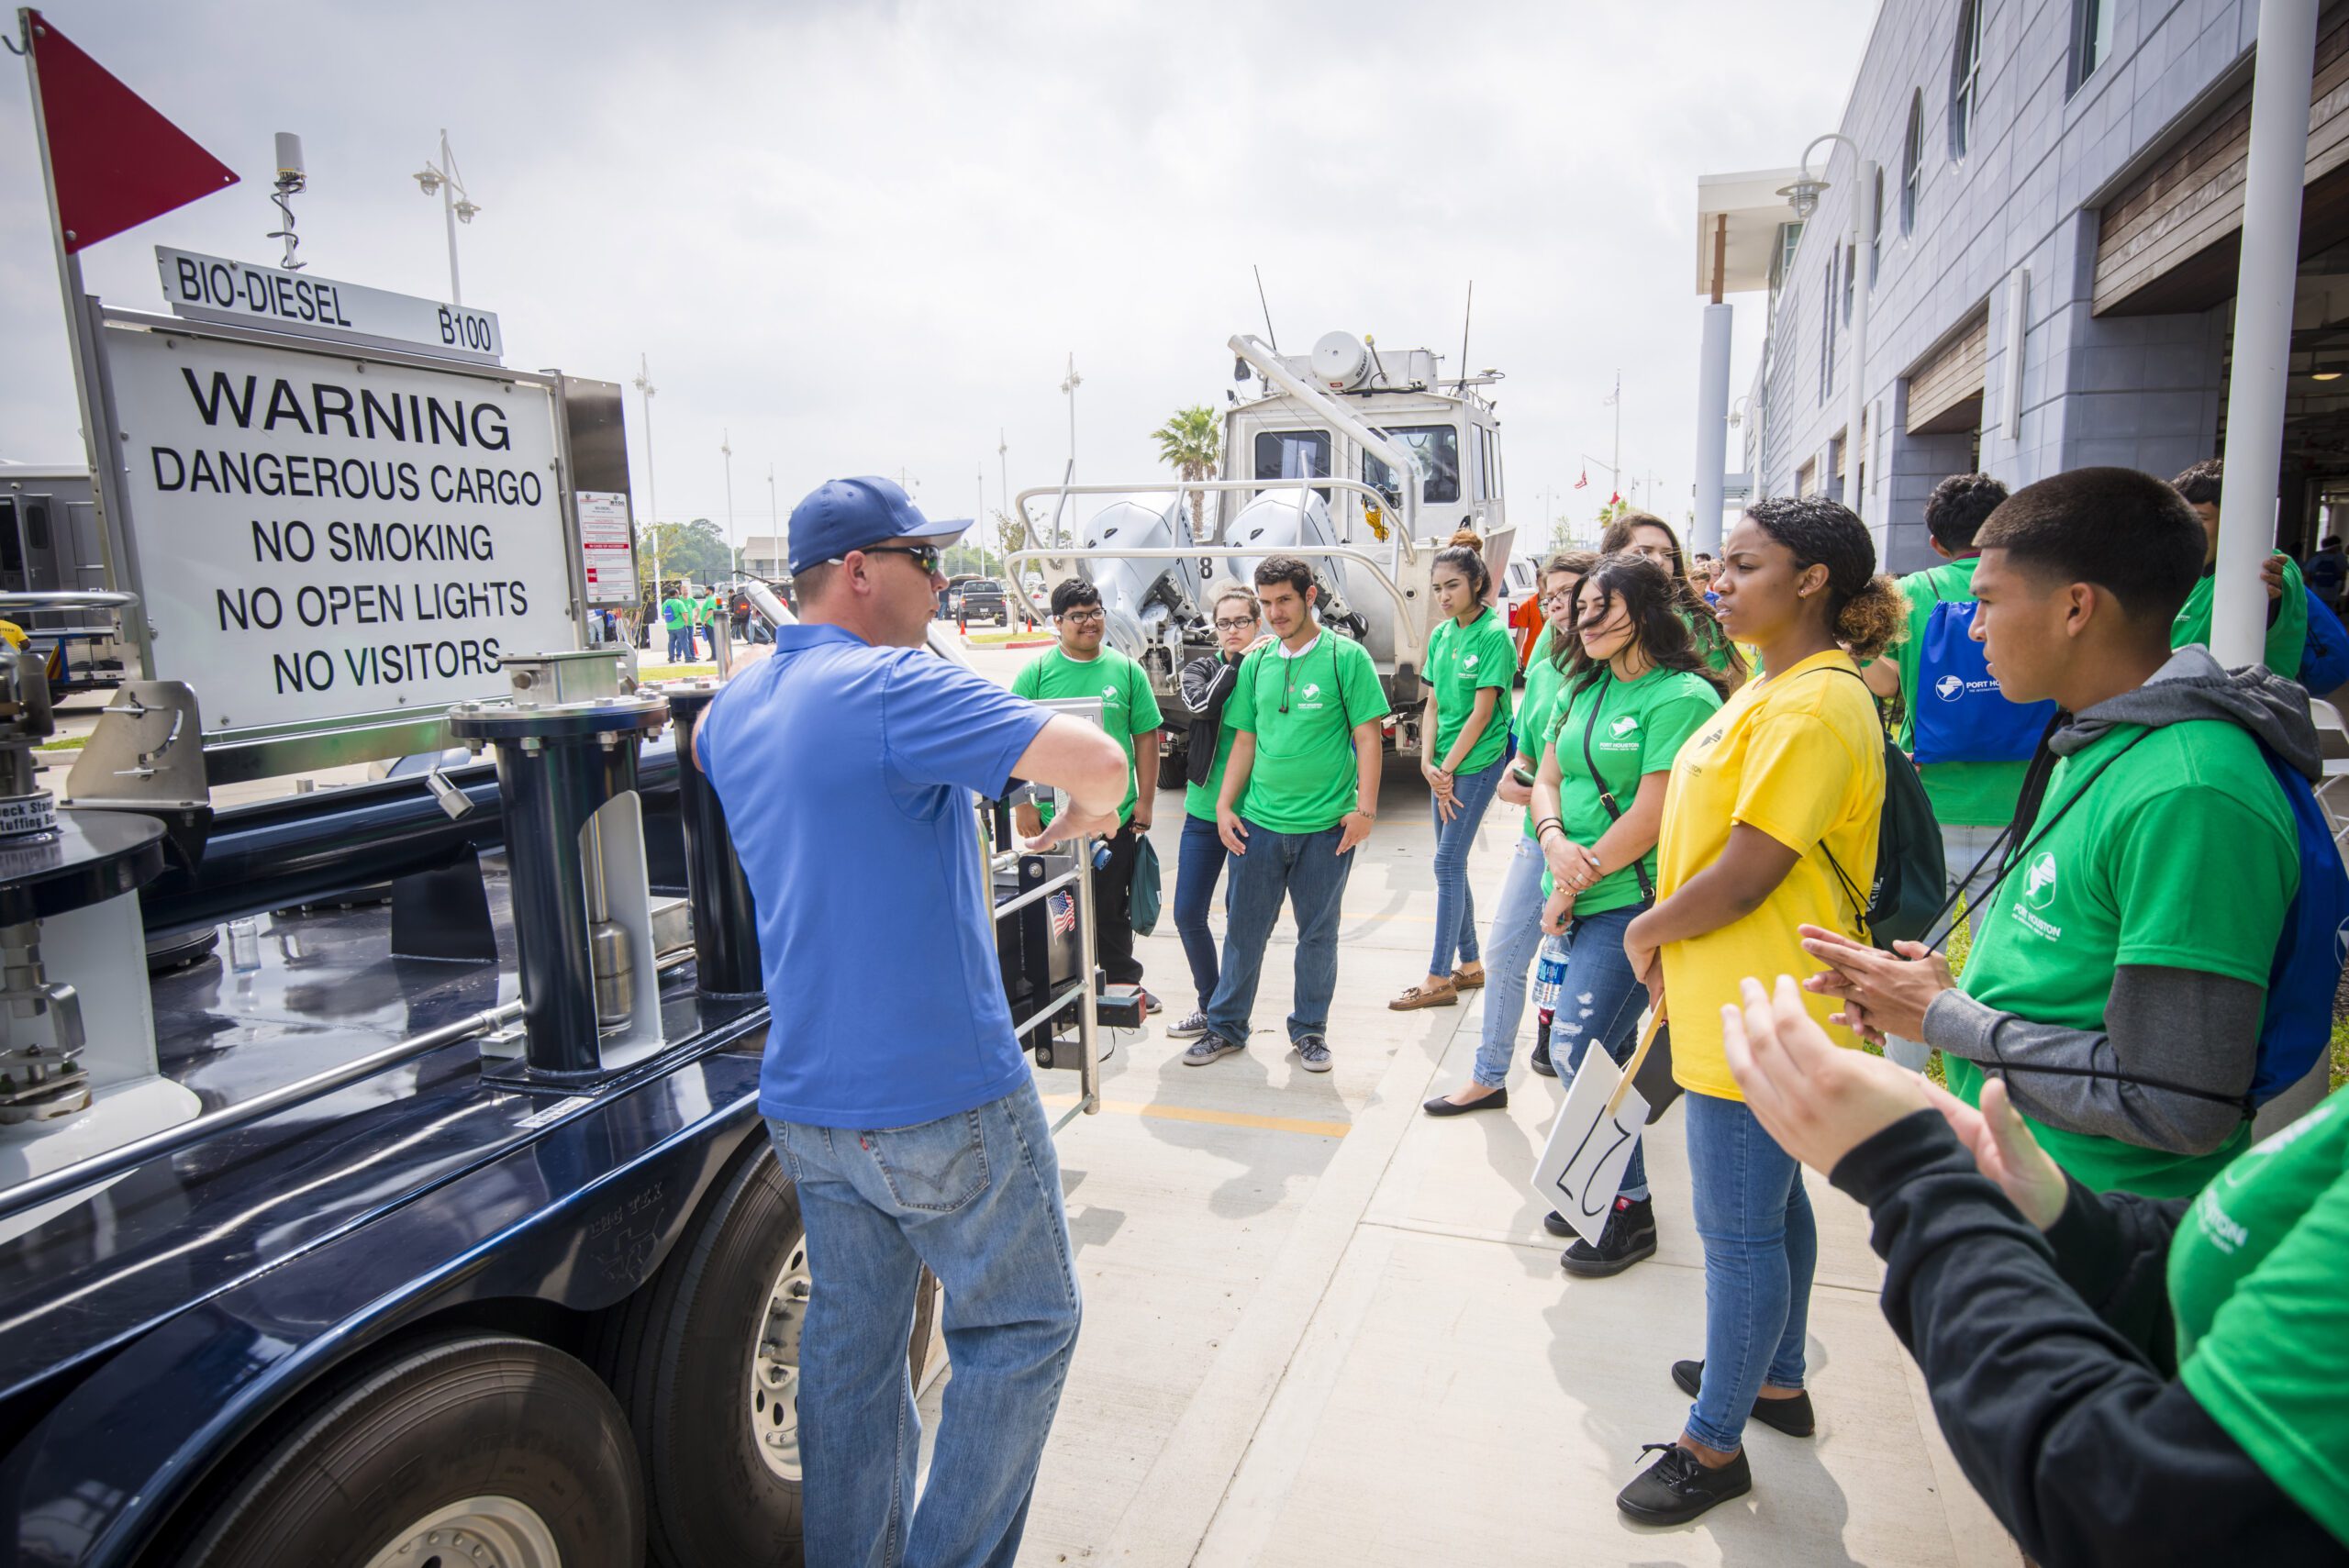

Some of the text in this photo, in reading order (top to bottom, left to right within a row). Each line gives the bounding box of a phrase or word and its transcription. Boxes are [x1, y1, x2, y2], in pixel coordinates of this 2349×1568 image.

[175, 256, 491, 351] BIO-DIESEL B100
[180, 366, 511, 451] WARNING
[150, 446, 541, 506] DANGEROUS CARGO
[251, 520, 494, 563] NO SMOKING
[215, 581, 528, 631] NO OPEN LIGHTS
[273, 638, 503, 695] NO VISITORS
[1966, 681, 1987, 689] PORT
[2028, 912, 2061, 937] HOUSTON
